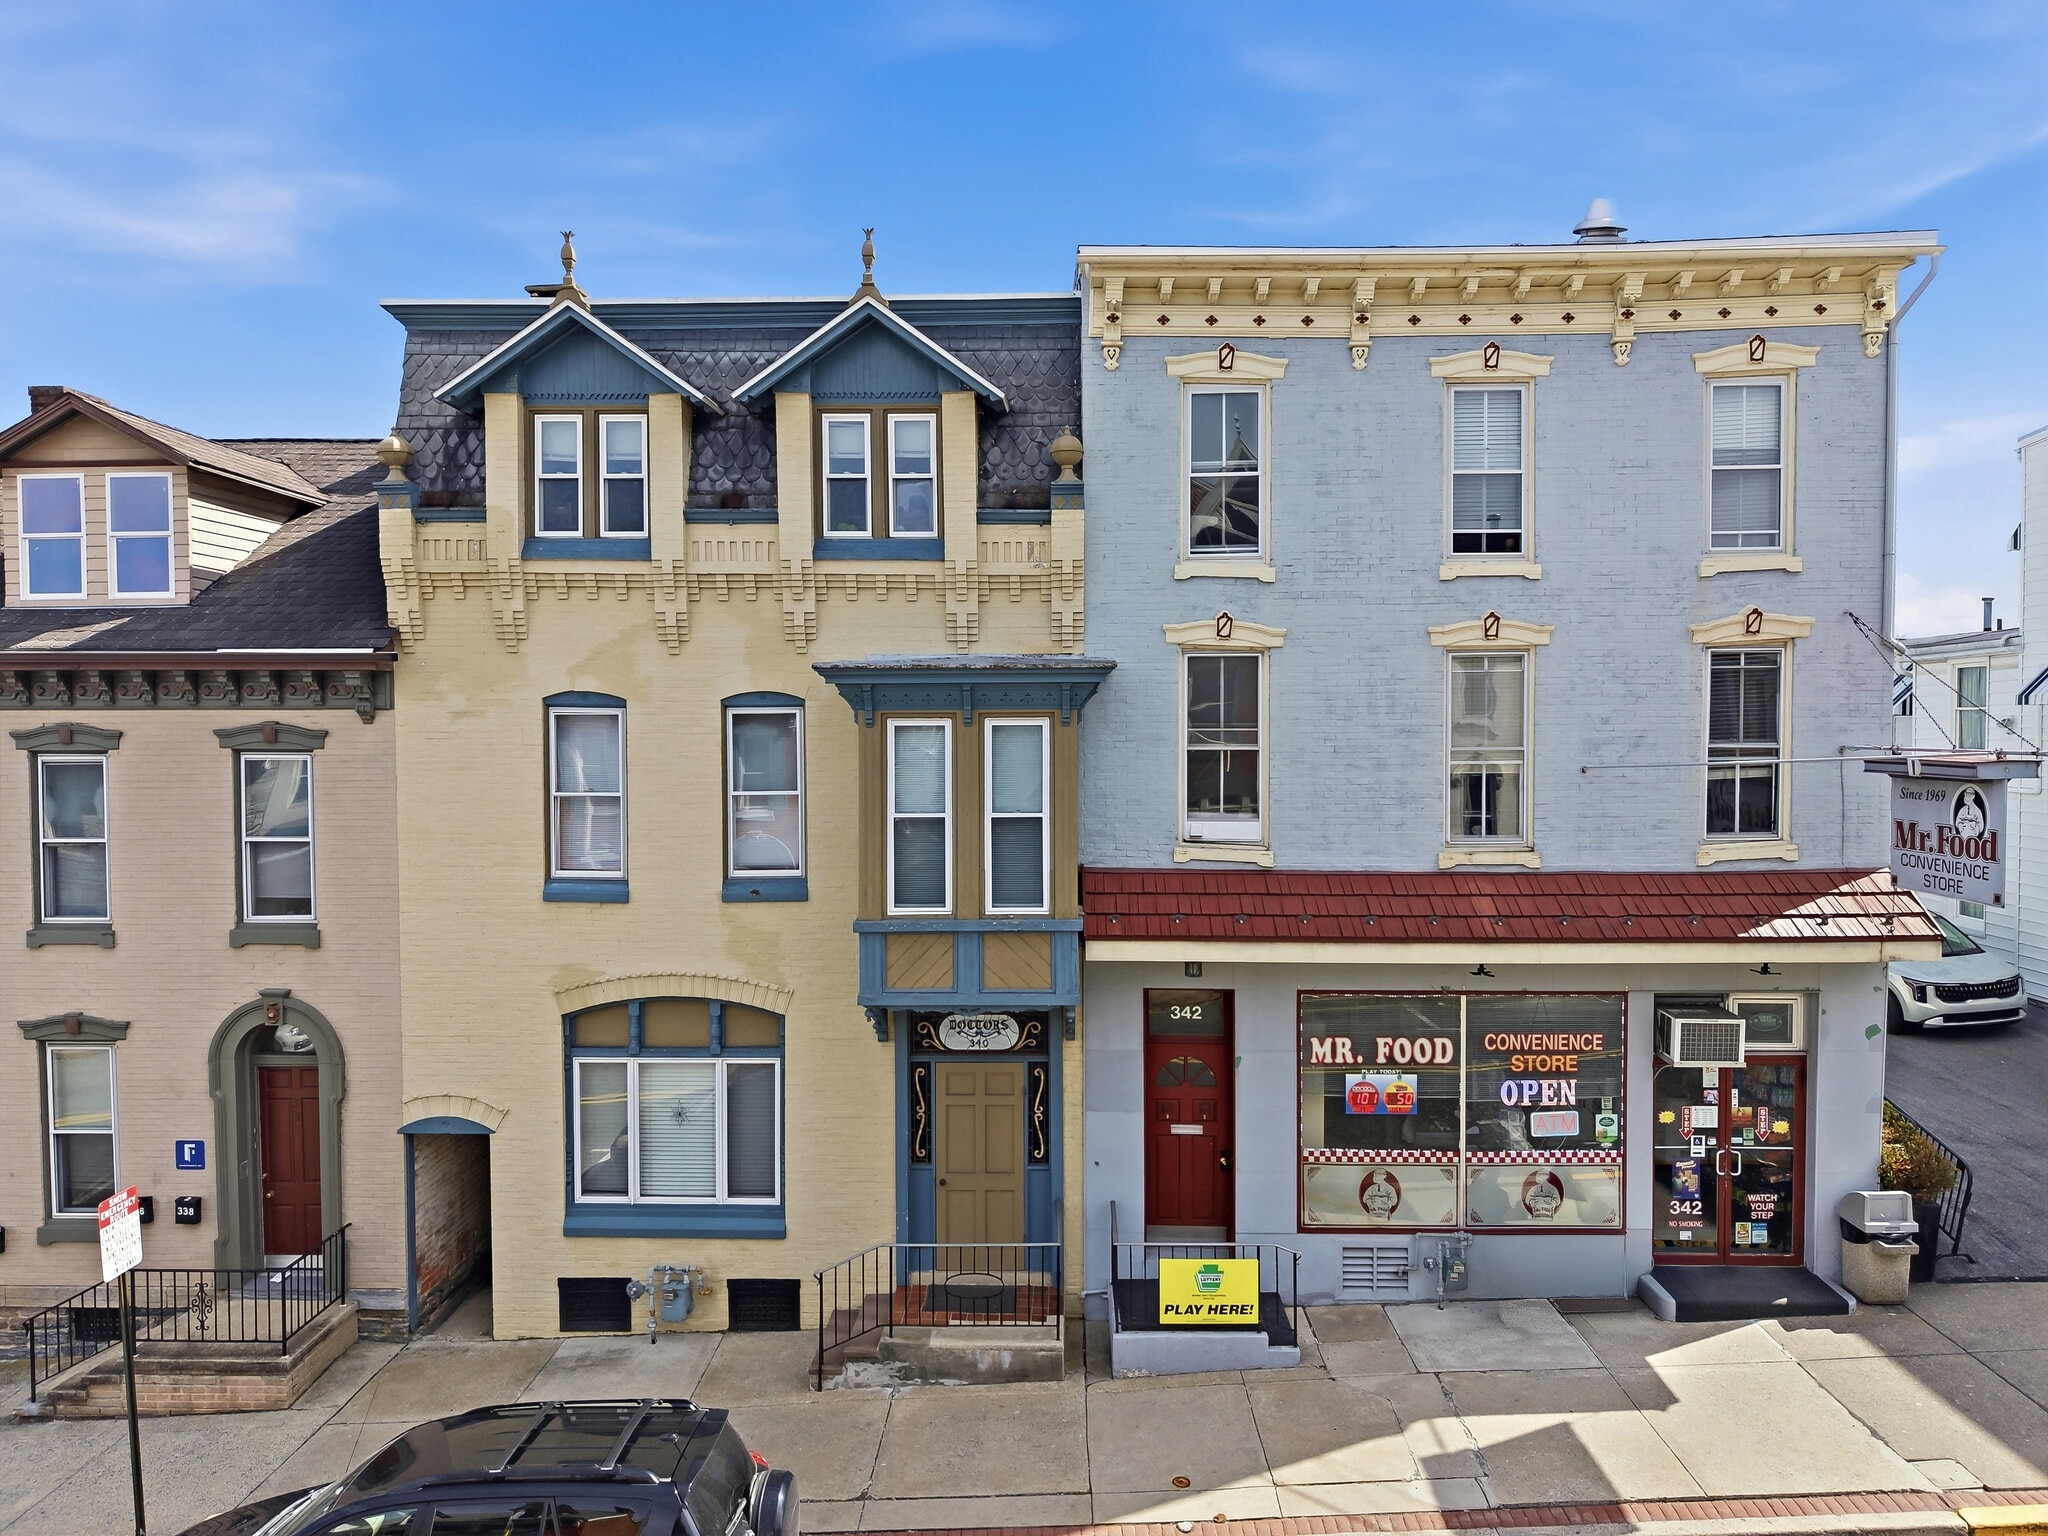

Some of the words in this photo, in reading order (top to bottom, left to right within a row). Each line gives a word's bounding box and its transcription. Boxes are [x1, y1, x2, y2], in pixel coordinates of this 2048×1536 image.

[1900, 787, 1923, 800] Since
[1925, 789, 1946, 802] 1969
[1900, 853, 1990, 881] CONVENIENCE
[1923, 874, 1964, 894] STORE
[1170, 1005, 1202, 1020] 342
[969, 1039, 989, 1048] 340
[1484, 1033, 1604, 1051] CONVENIENCE
[1309, 1036, 1364, 1065] MR.
[1375, 1036, 1455, 1065] FOOD
[1510, 1054, 1579, 1072] STORE
[1397, 1092, 1413, 1105] 50
[1500, 1079, 1578, 1107] OPEN
[1534, 1114, 1577, 1133] ATM
[1747, 1194, 1778, 1202] WATCH
[177, 1206, 194, 1216] 338
[1669, 1200, 1703, 1215] 342
[1749, 1202, 1775, 1210] YOUR
[1750, 1211, 1774, 1219] STEP
[1668, 1220, 1678, 1228] NO
[1678, 1220, 1704, 1228] SMOKING
[1164, 1304, 1204, 1315] PLAY
[1207, 1304, 1254, 1315] HERE!
